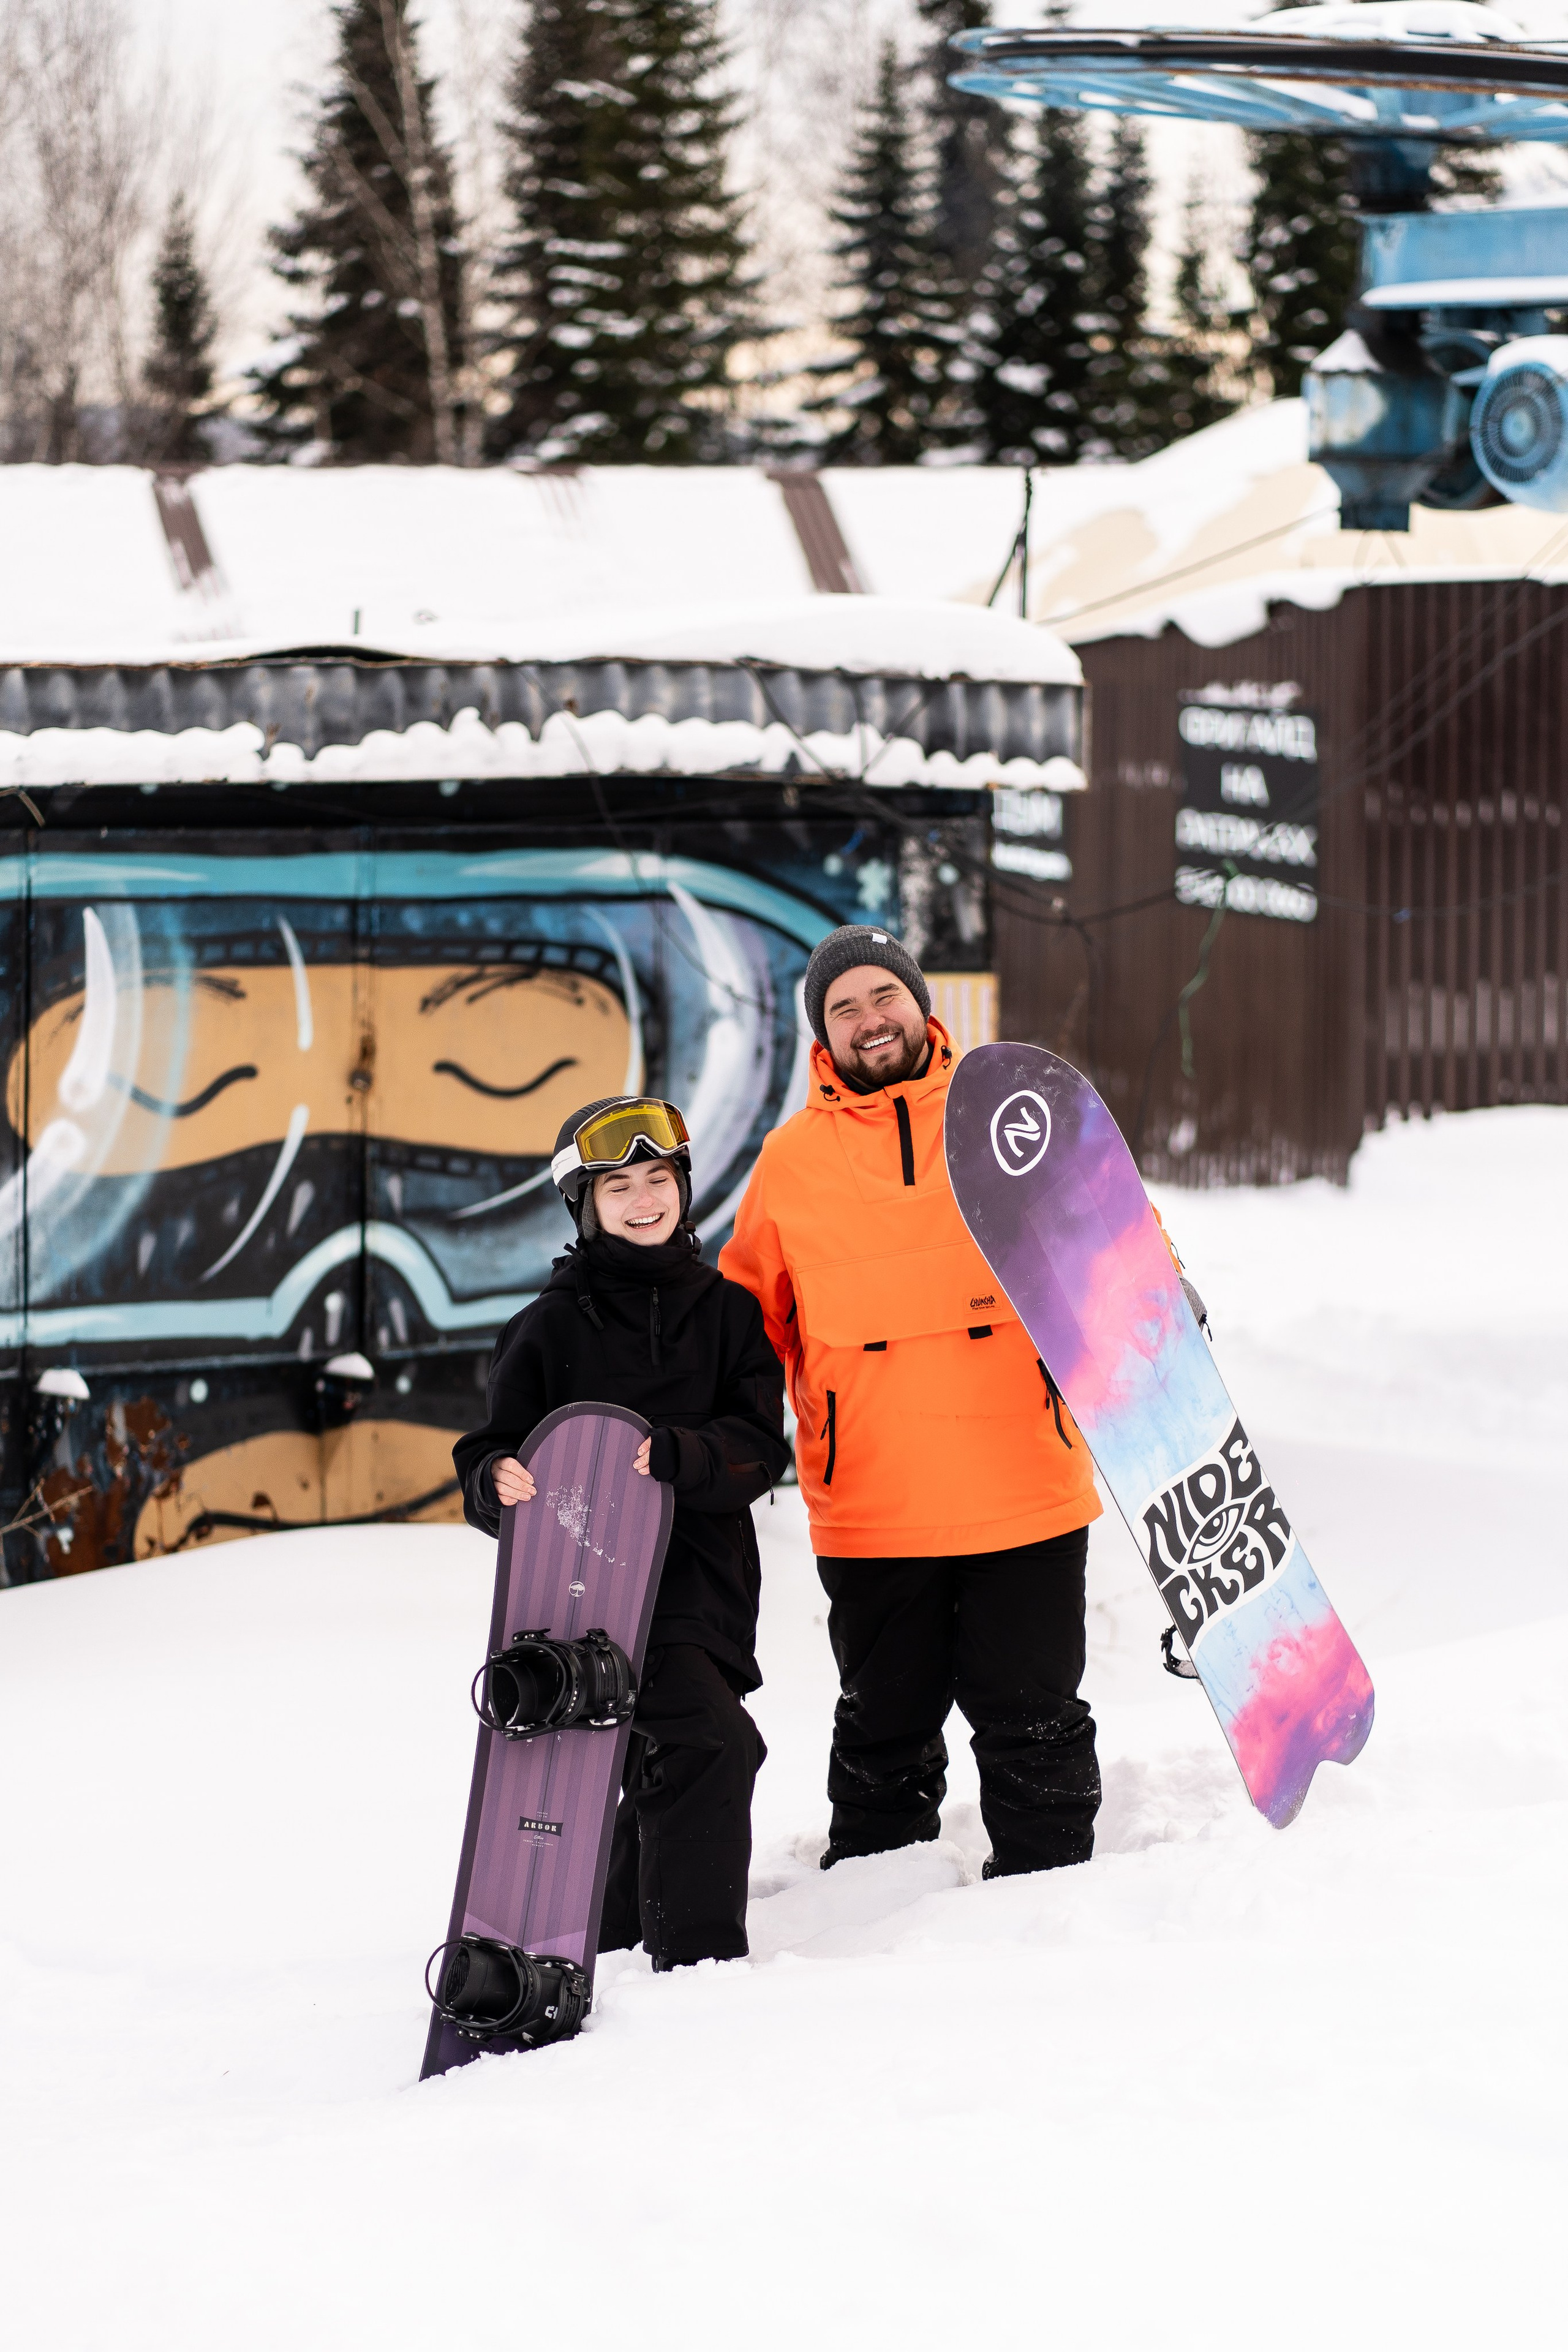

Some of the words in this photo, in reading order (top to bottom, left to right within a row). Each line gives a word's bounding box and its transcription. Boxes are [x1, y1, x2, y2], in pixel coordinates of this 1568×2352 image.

[970, 1295, 996, 1308] CHUKCHA
[1142, 1416, 1262, 1586] NIDE
[1161, 1486, 1291, 1649] CKER
[524, 1821, 557, 1832] ARBOR
